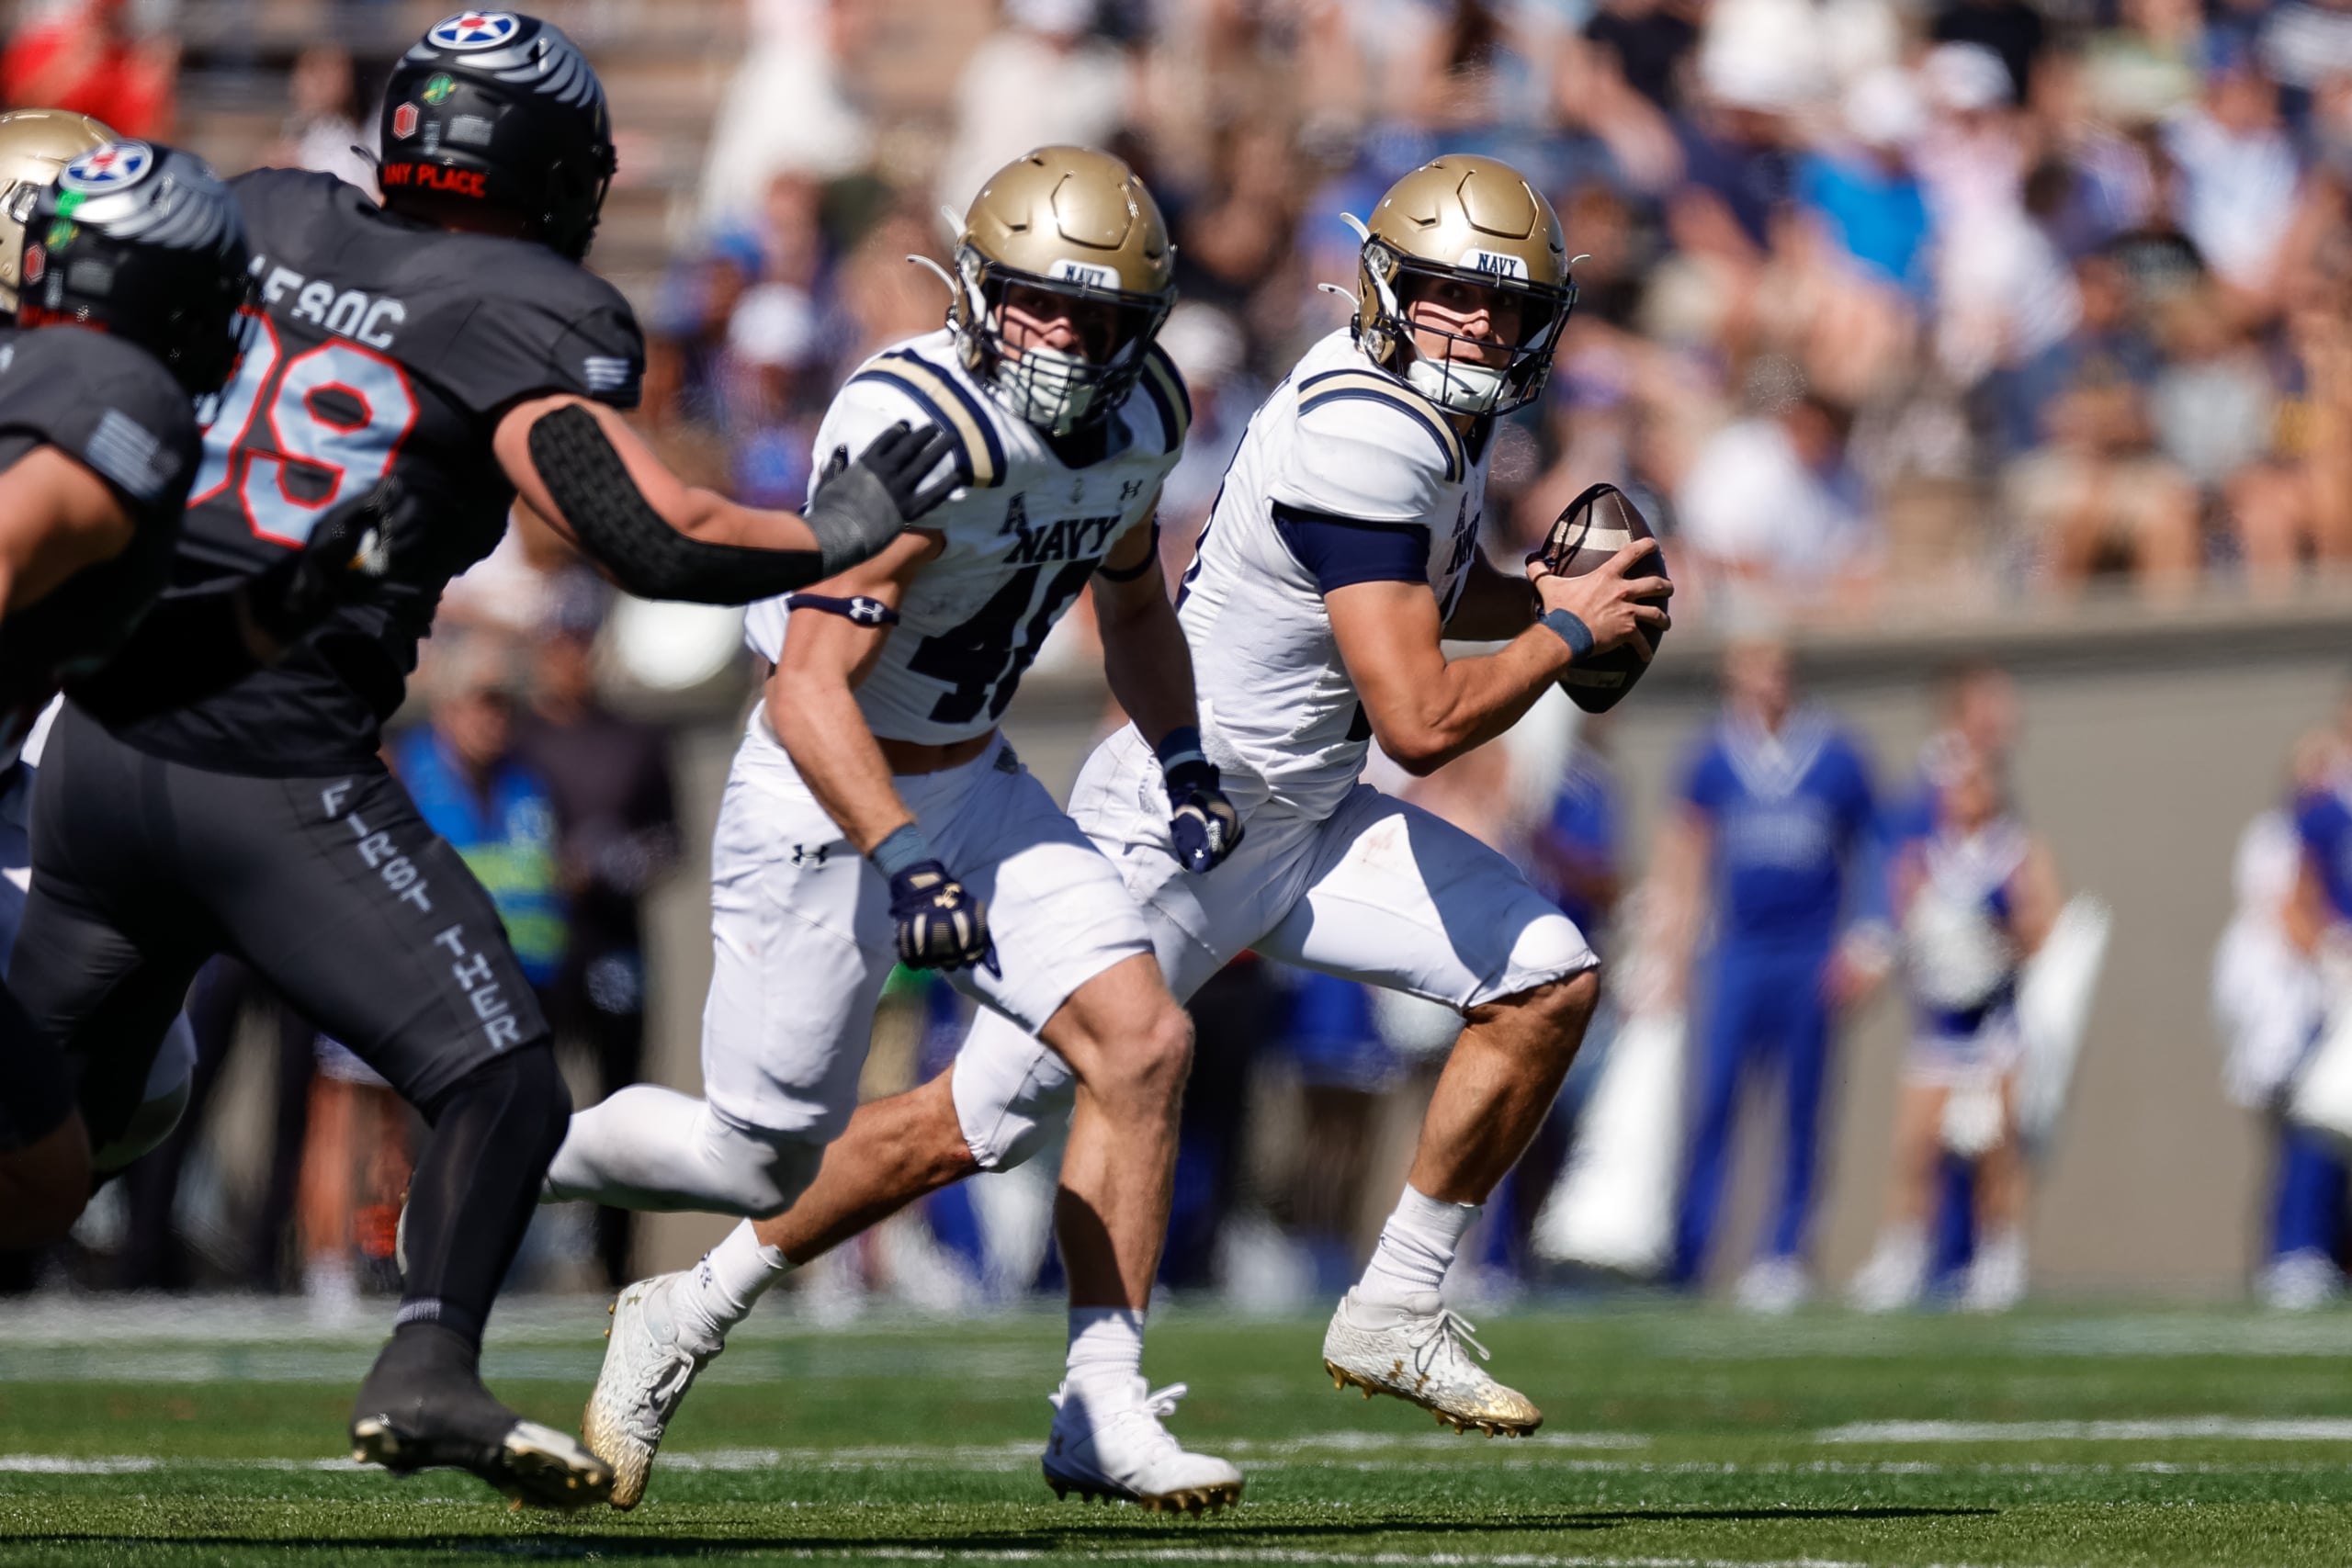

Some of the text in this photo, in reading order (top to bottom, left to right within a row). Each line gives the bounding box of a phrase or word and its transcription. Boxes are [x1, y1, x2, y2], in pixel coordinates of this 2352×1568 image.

[384, 163, 487, 198] ANY PLACE
[1065, 264, 1107, 288] NAVY
[1476, 253, 1518, 278] NAVY
[1001, 513, 1123, 564] NAVY
[322, 780, 522, 1050] FIRST THER
